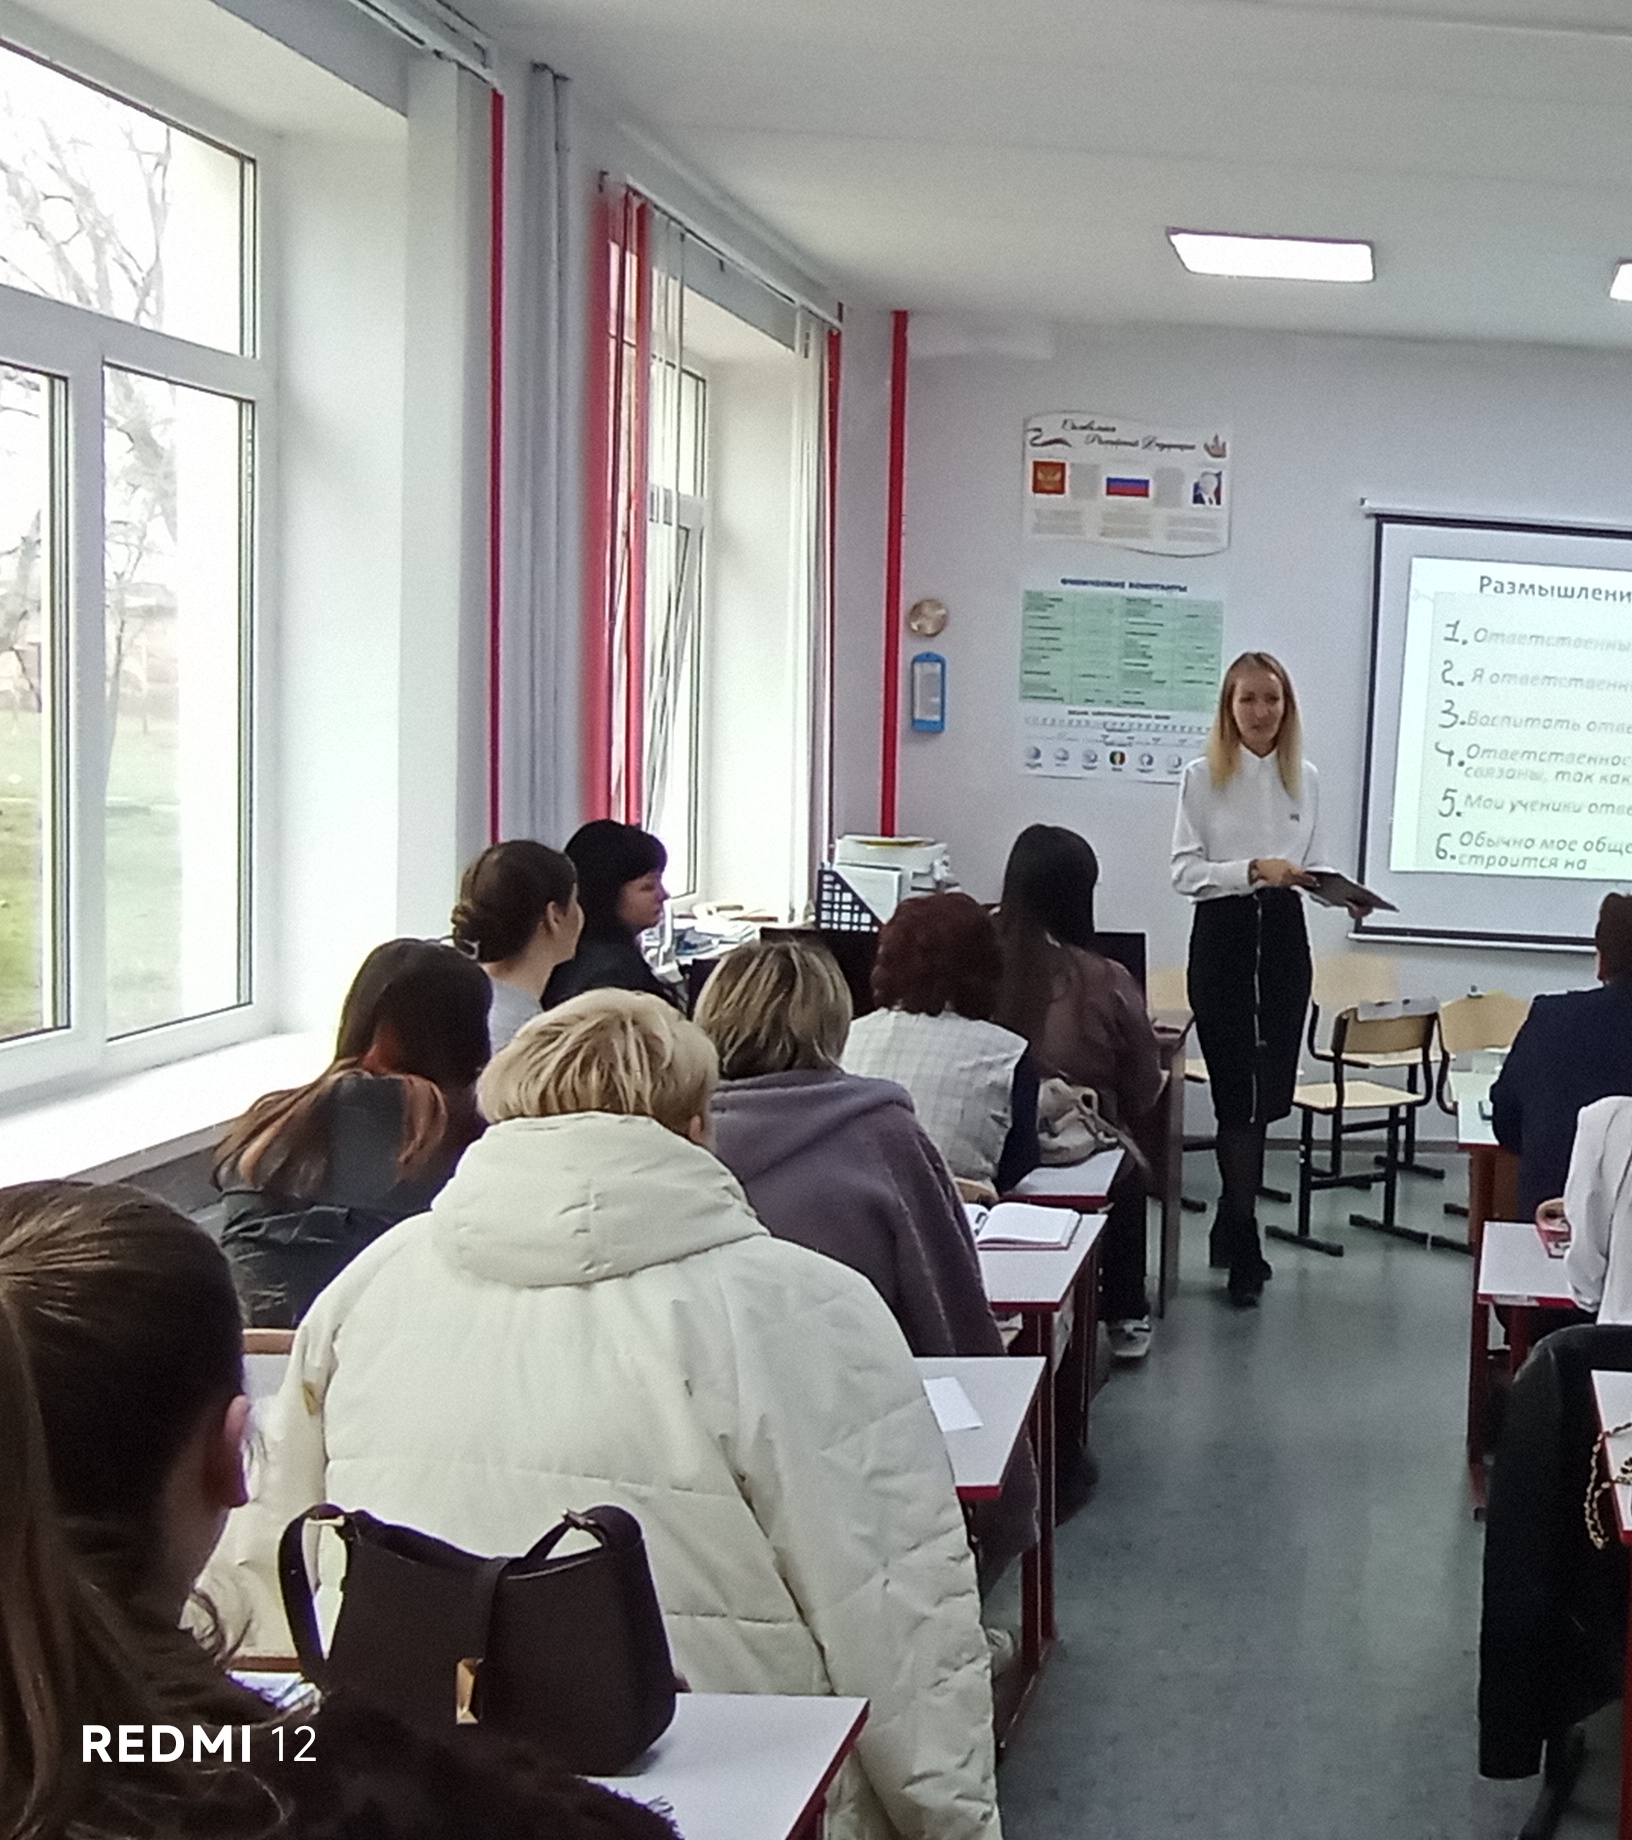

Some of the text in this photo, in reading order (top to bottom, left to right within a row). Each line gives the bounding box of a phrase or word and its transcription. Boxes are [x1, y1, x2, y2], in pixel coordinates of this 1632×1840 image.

[1443, 619, 1468, 645] 1.
[1441, 659, 1464, 686] 2.
[1471, 667, 1485, 683] Я
[1438, 699, 1466, 729] 3.
[1466, 709, 1580, 732] Воспитать
[1434, 741, 1465, 768] 4.
[1554, 769, 1594, 783] так
[1438, 787, 1462, 818] 5.
[1464, 793, 1504, 810] Мои
[1509, 799, 1582, 814] ученики
[1435, 832, 1456, 860] 6.
[1459, 830, 1535, 849] Обычно
[1540, 838, 1578, 852] мое
[1458, 852, 1587, 871] строится на
